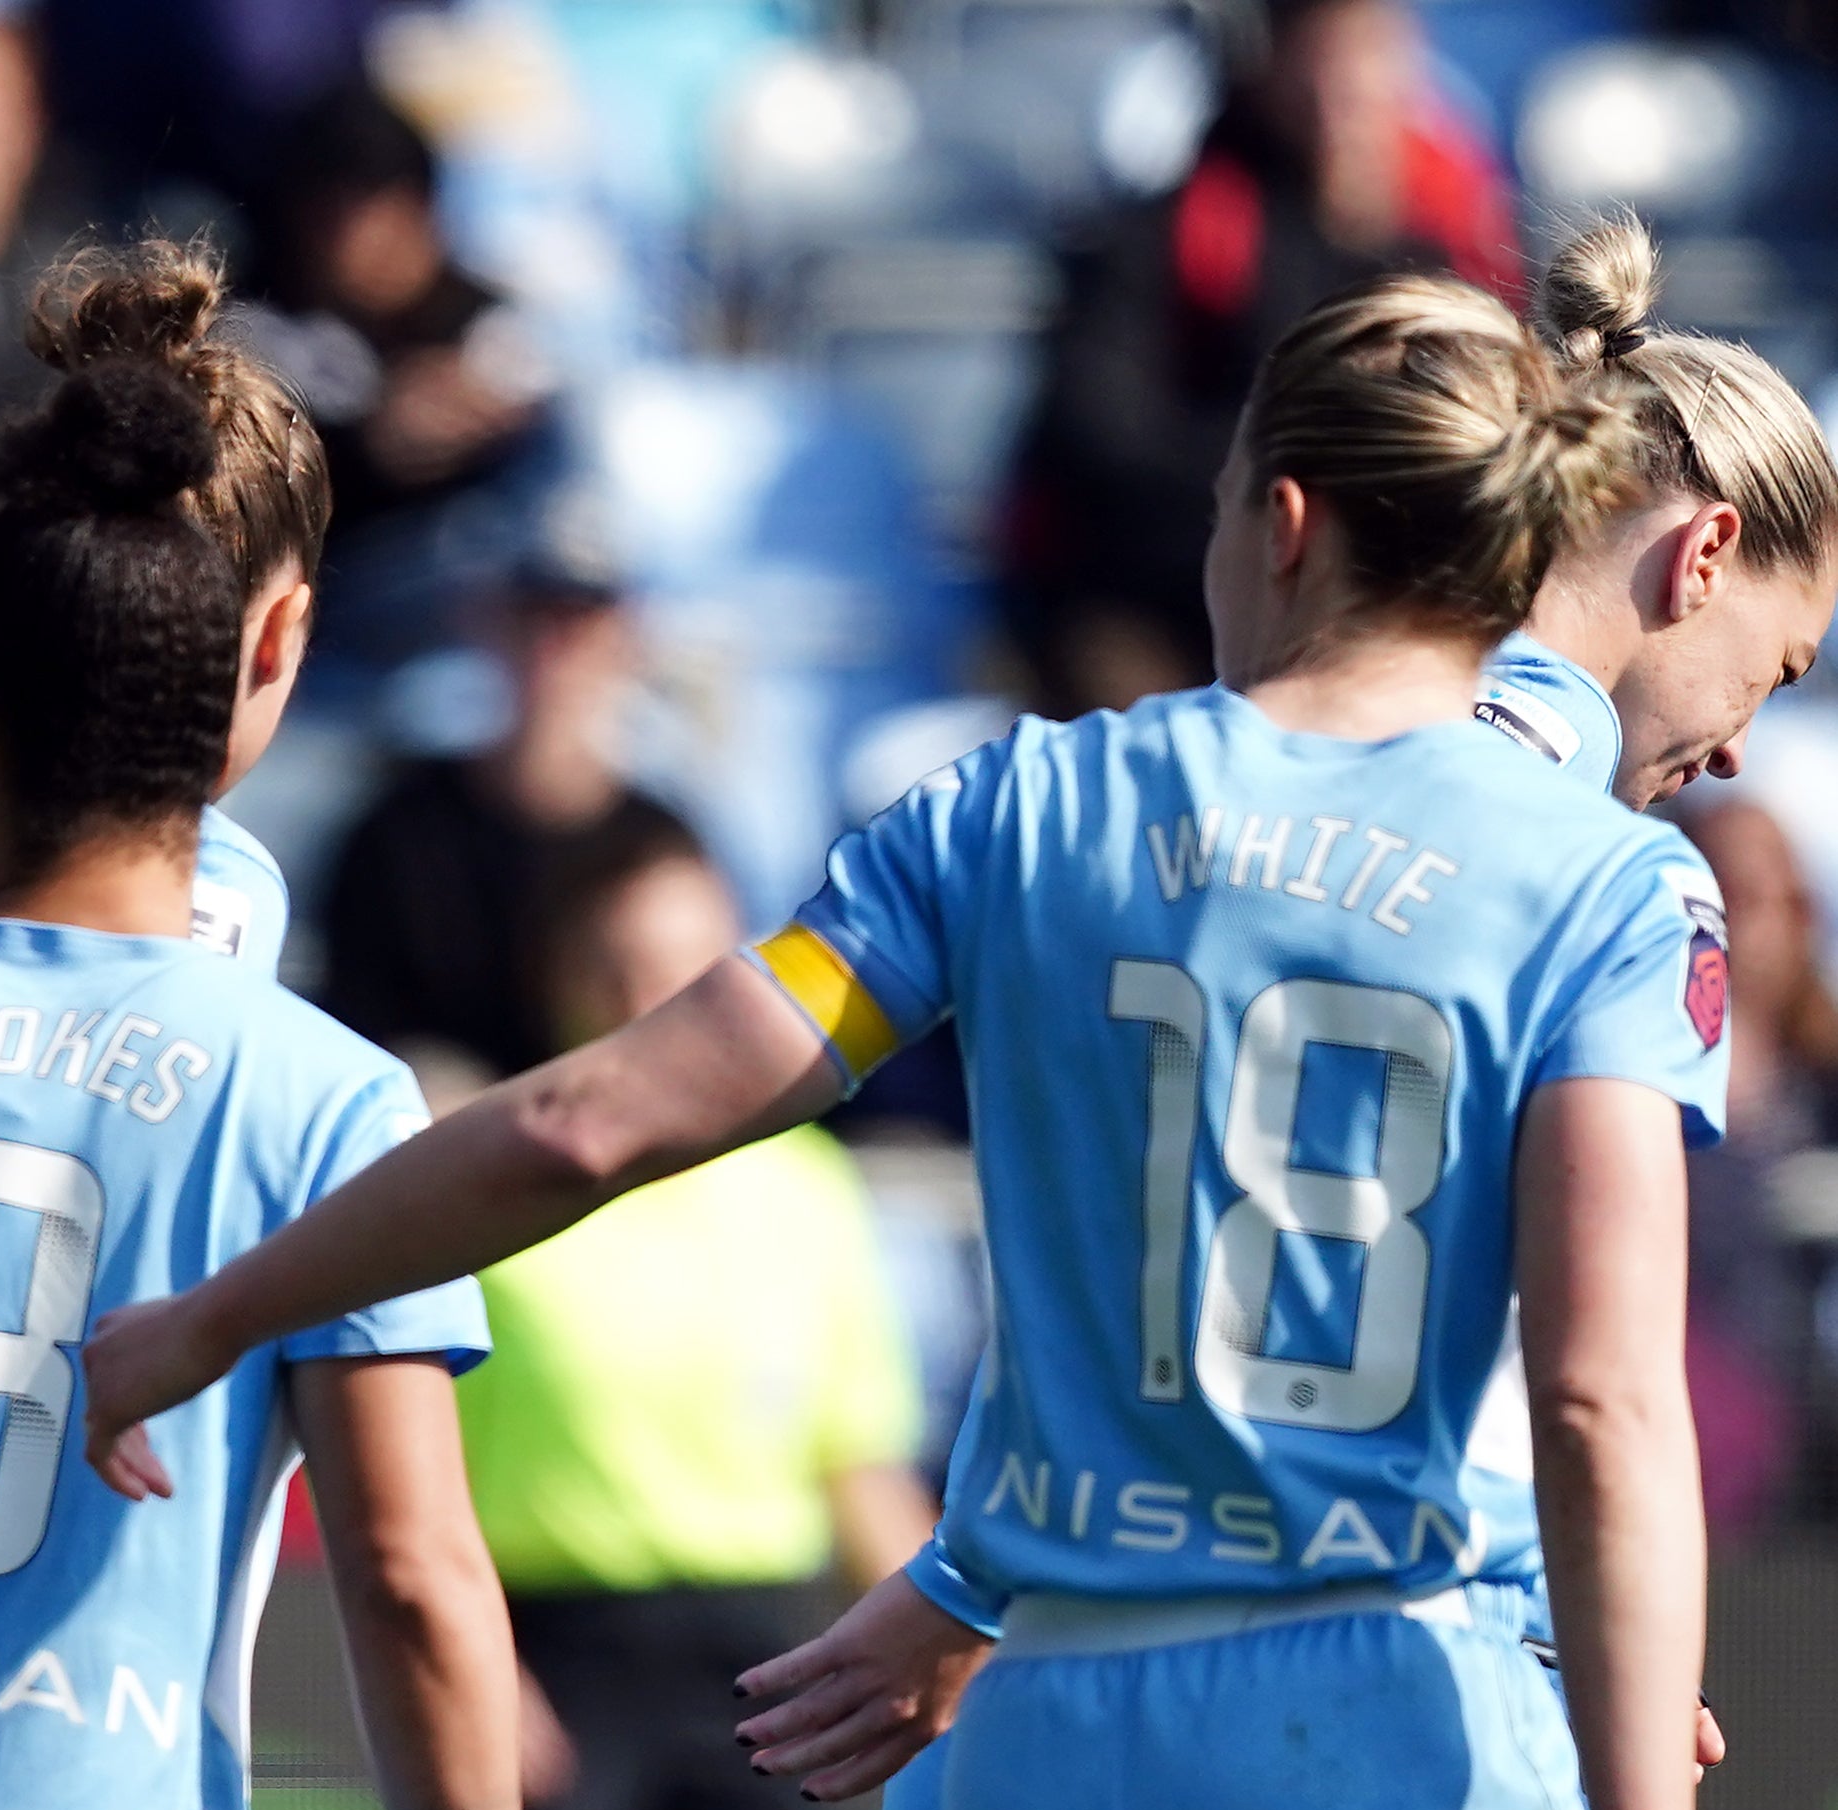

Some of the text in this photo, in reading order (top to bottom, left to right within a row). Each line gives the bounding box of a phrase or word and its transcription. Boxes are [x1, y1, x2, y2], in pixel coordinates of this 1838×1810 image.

[1145, 806, 1461, 936] WHITE
[1108, 955, 1453, 1434] 18
[983, 1452, 1488, 1577] NISSAN
